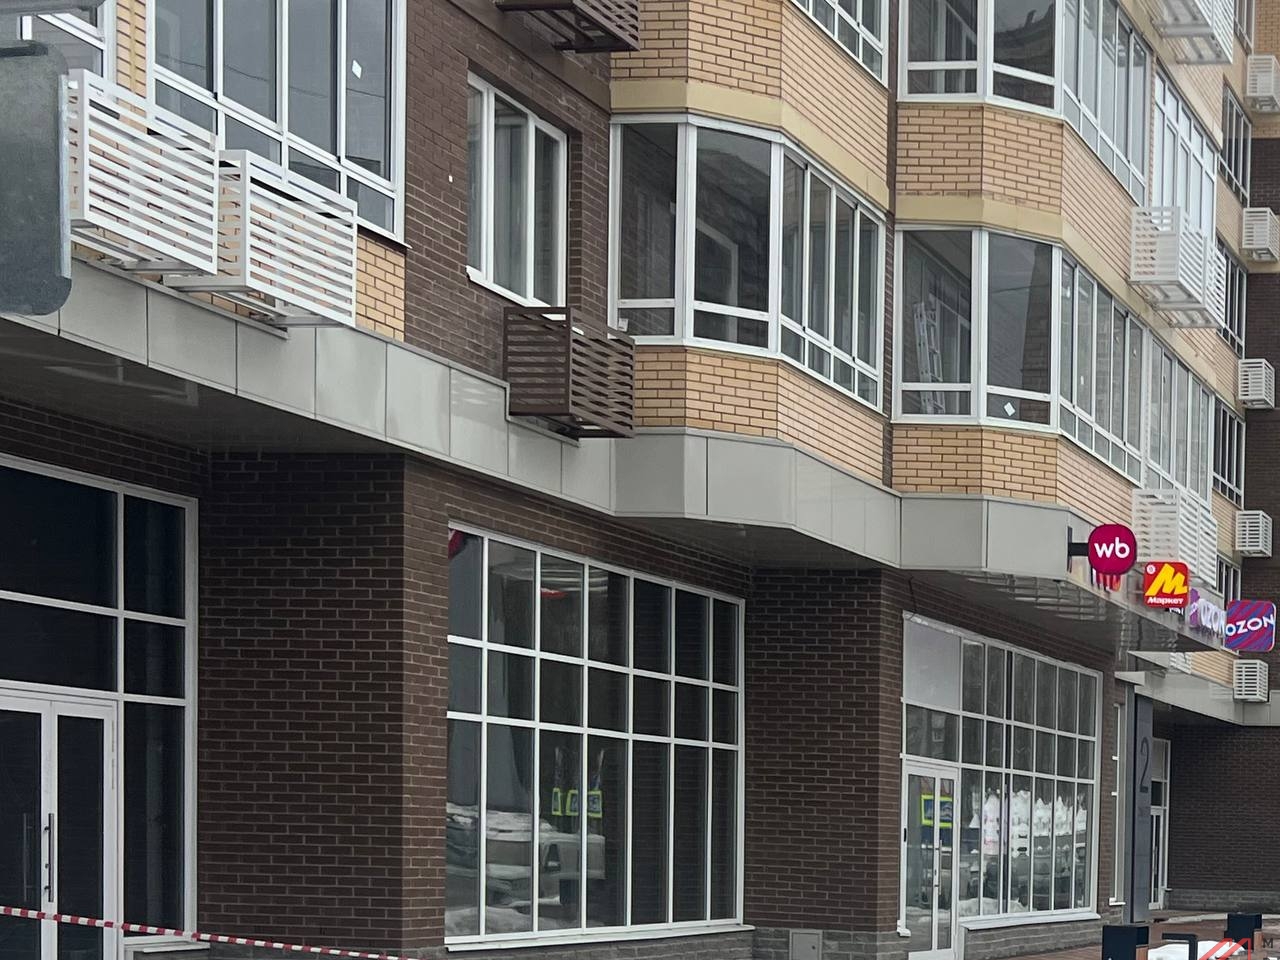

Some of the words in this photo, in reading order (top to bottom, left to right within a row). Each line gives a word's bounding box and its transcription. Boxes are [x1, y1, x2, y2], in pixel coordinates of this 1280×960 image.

[1094, 537, 1130, 558] wb
[1147, 597, 1184, 606] Маркет
[1225, 614, 1275, 637] OZON
[1139, 737, 1149, 793] 2
